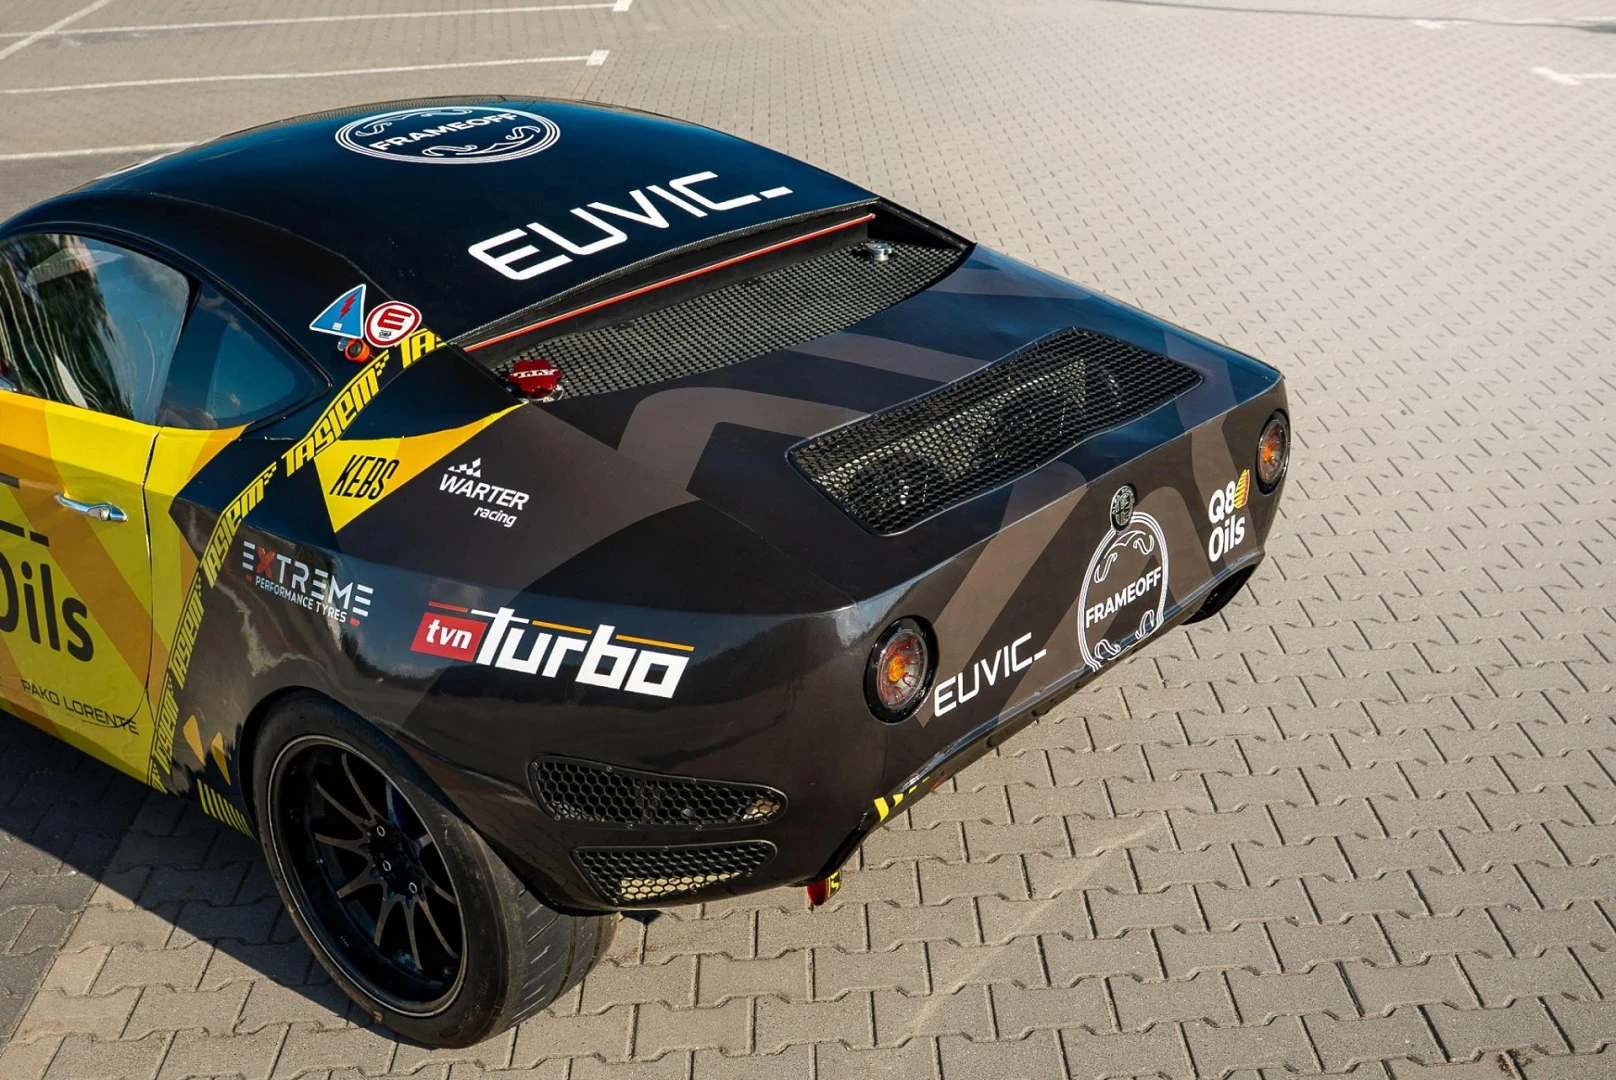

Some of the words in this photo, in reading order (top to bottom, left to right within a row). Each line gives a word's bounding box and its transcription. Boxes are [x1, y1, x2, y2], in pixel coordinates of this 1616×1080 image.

[369, 112, 518, 151] FRAMEOFF
[329, 454, 400, 501] KEBS
[439, 473, 530, 511] WARTER
[473, 506, 517, 528] racing
[1208, 480, 1236, 524] Q8
[1208, 514, 1245, 562] Oils
[242, 540, 374, 618] EXTREME
[255, 575, 314, 611] PERFORMANCE
[316, 601, 348, 623] TYRES
[1085, 566, 1162, 628] FRAMEOFF
[425, 619, 473, 650] tvn
[470, 606, 690, 699] turbo
[21, 679, 61, 707] PAKO
[63, 697, 139, 735] LORENTE
